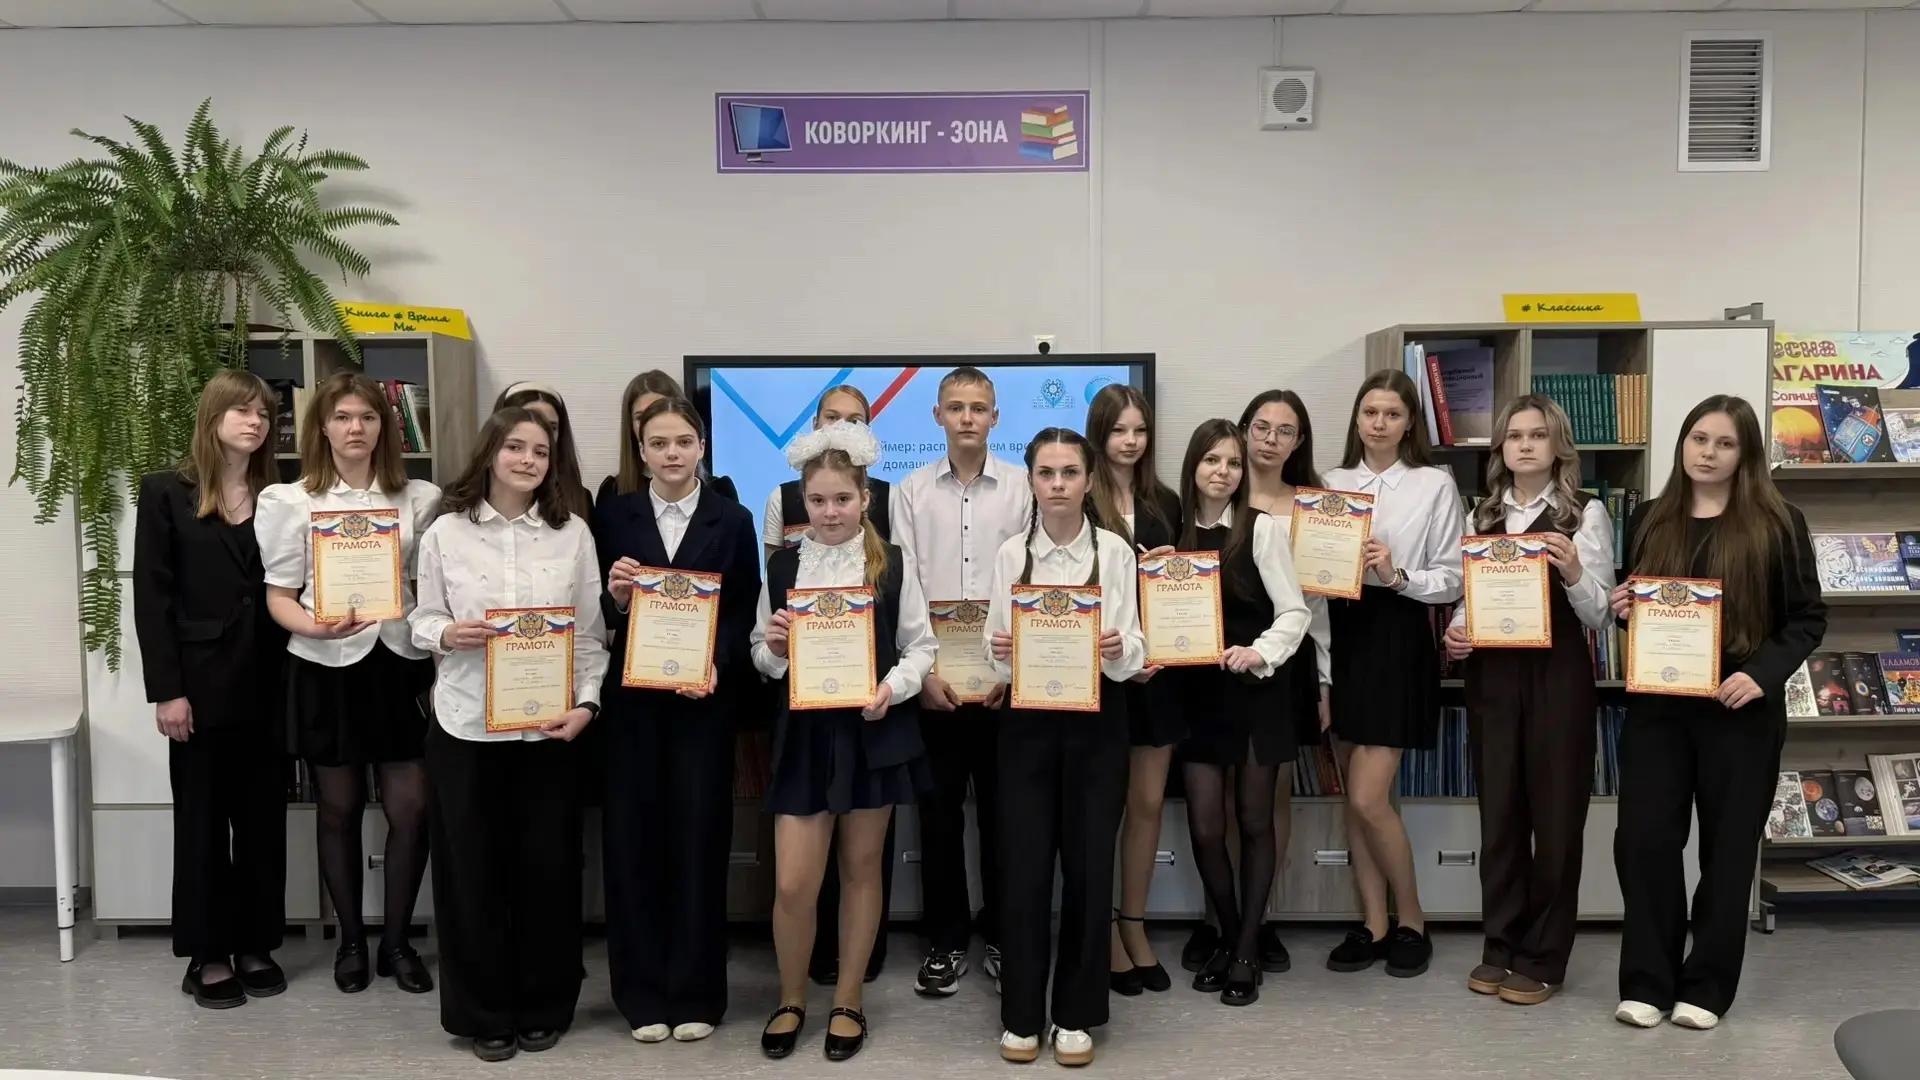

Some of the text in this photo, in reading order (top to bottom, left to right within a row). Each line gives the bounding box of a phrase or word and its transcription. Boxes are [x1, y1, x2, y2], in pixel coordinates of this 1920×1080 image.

[804, 120, 932, 145] КОВОРКИНГ
[950, 119, 1009, 144] ЗОНА
[1537, 302, 1604, 312] Классика
[345, 306, 390, 319] Книга
[407, 311, 451, 323] Время
[393, 322, 416, 331] Мы
[1773, 340, 1838, 359] есна
[1772, 363, 1884, 381] АГАРИНА
[1772, 390, 1818, 403] Солнце
[881, 440, 916, 454] ймер:
[1307, 516, 1353, 529] ГРАМОТА
[331, 540, 382, 550] ГРАМОТА
[1481, 564, 1530, 574] ГРАМОТА
[1156, 582, 1203, 592] ГРАМОТА
[649, 600, 699, 613] ГРАМОТА
[1647, 608, 1701, 619] ГРАМОТА
[806, 620, 856, 630] ГРАМОТА
[946, 625, 985, 633] ГРАМОТ
[1030, 619, 1081, 629] ГРАМОТА
[505, 640, 555, 651] ГРАМОТА
